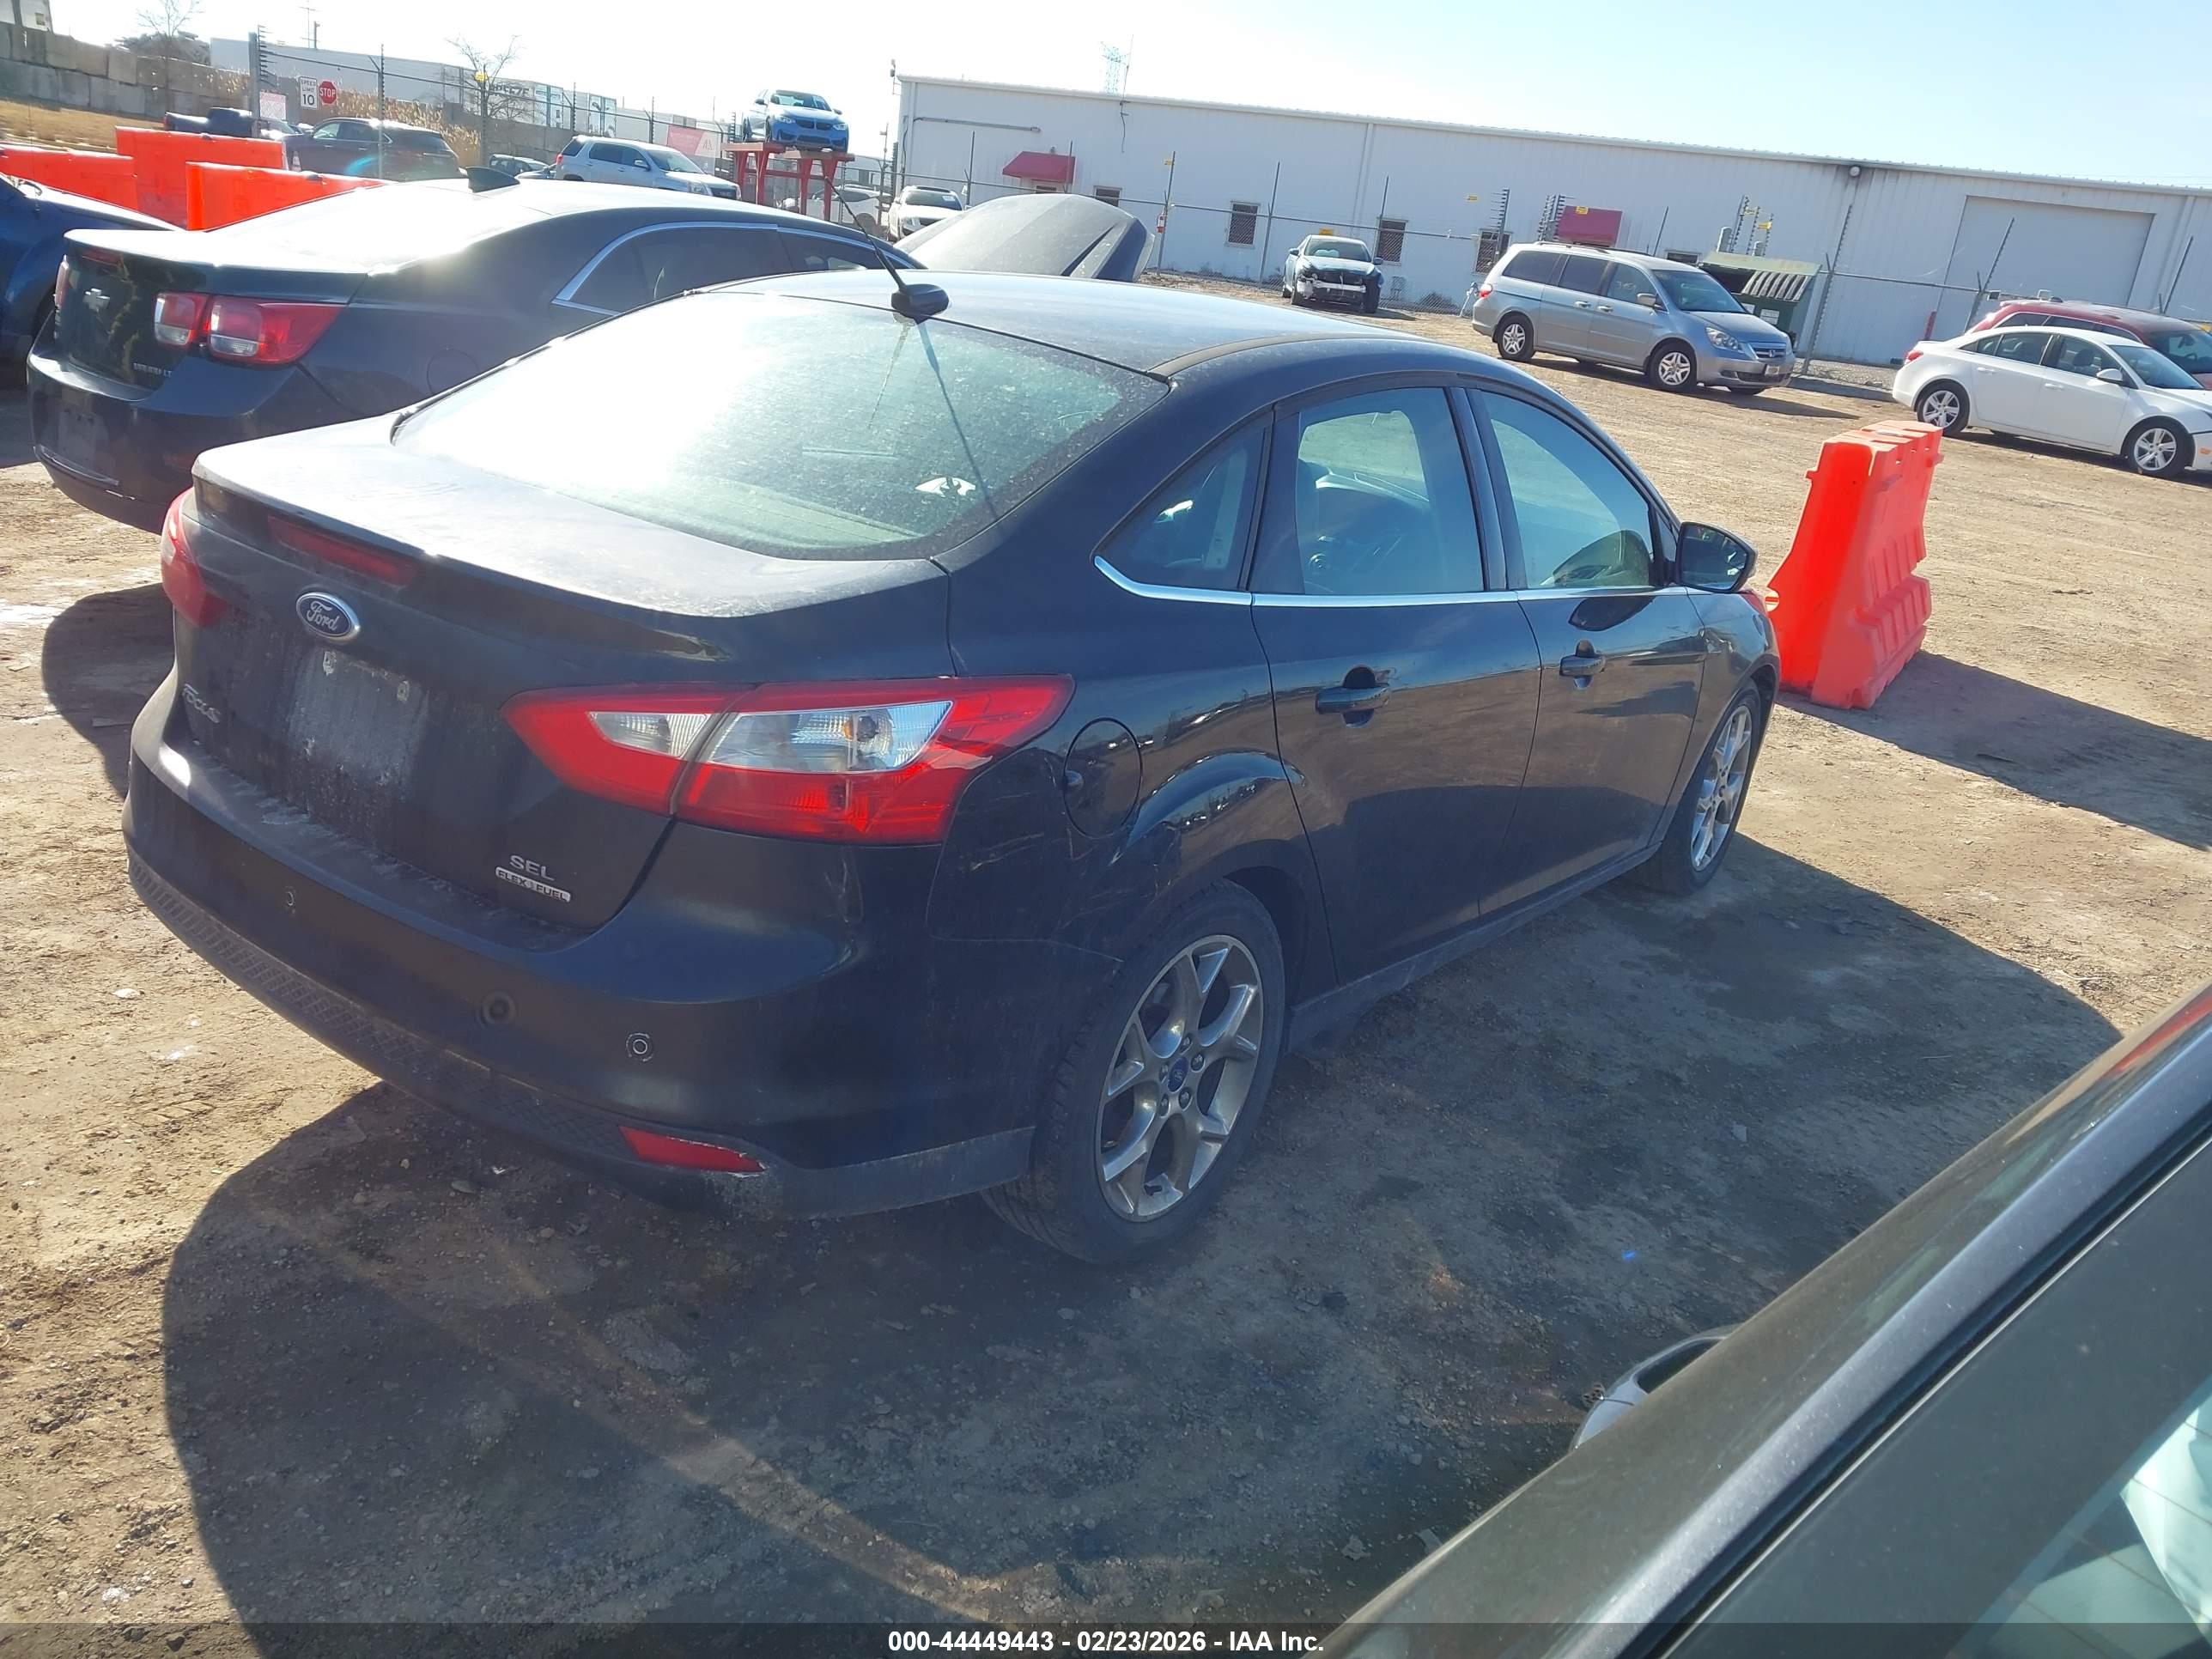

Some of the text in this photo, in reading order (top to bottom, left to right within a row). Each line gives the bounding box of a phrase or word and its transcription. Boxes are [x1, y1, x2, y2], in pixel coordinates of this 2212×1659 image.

[302, 94, 315, 106] 10
[319, 88, 336, 100] STOP
[307, 600, 341, 631] Ford
[509, 854, 555, 881] SEL
[498, 870, 568, 902] FLEX FUEL
